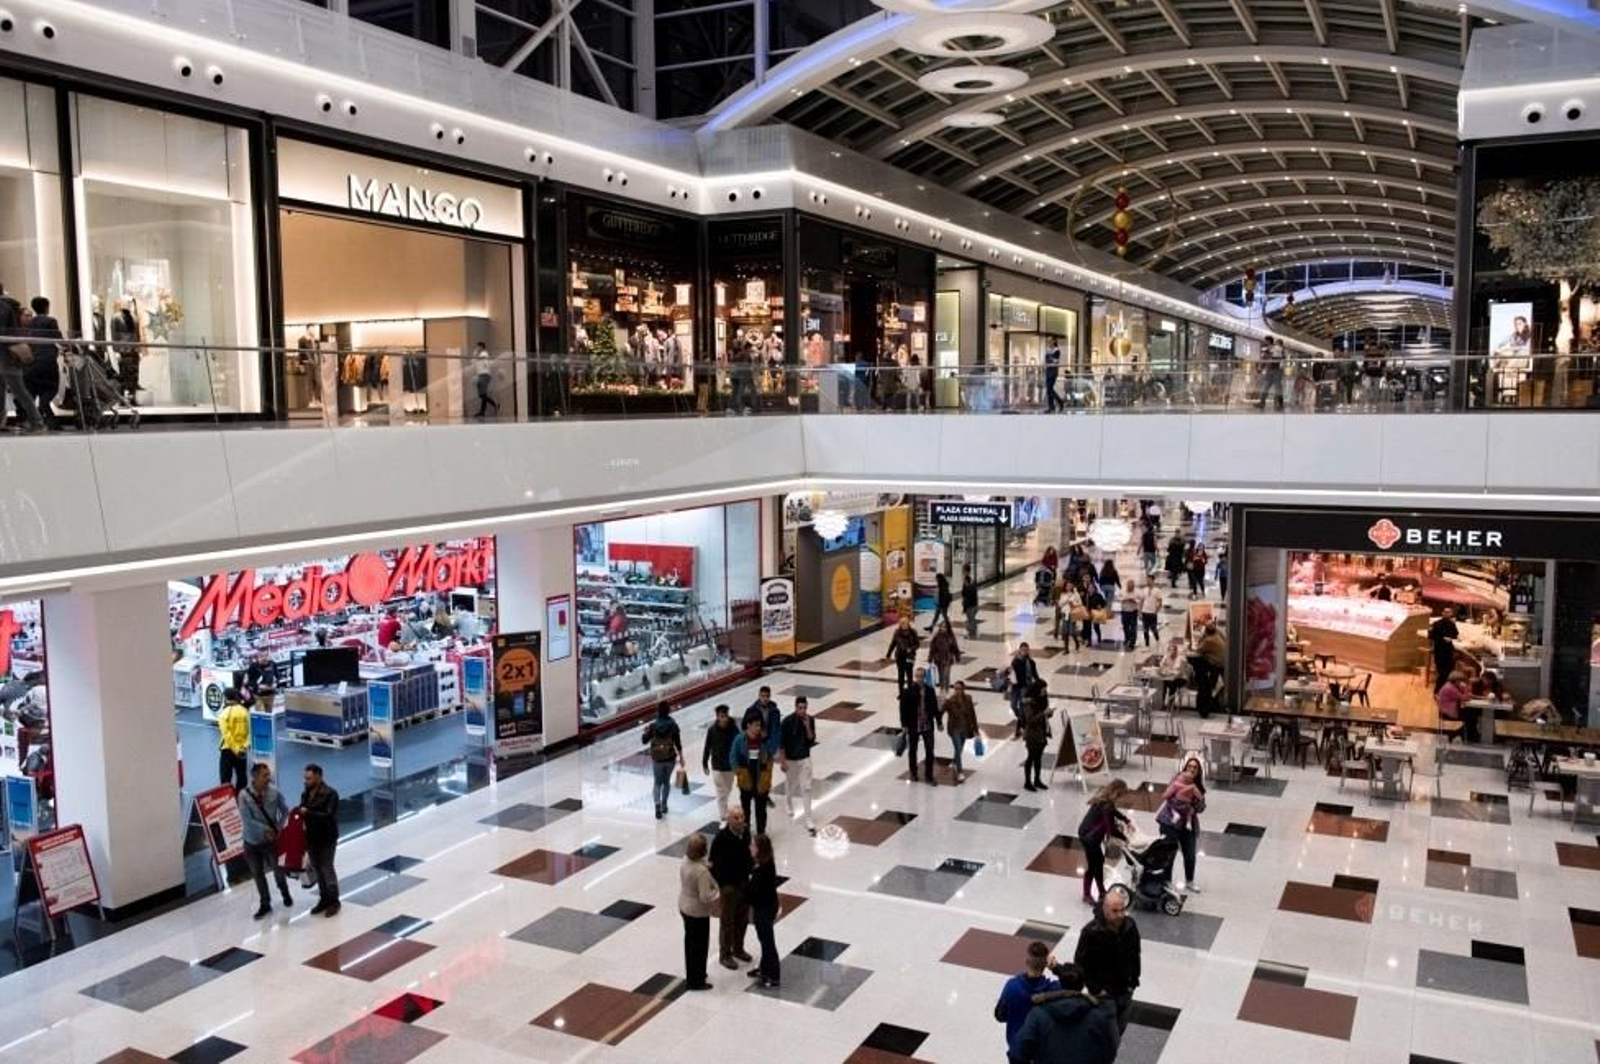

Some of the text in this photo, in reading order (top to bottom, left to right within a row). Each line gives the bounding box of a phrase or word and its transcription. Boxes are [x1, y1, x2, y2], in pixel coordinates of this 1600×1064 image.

[347, 174, 482, 228] MANGO
[936, 505, 999, 516] PLAZA CENTRAL
[1406, 528, 1503, 547] BEHER
[501, 658, 536, 682] 2x1
